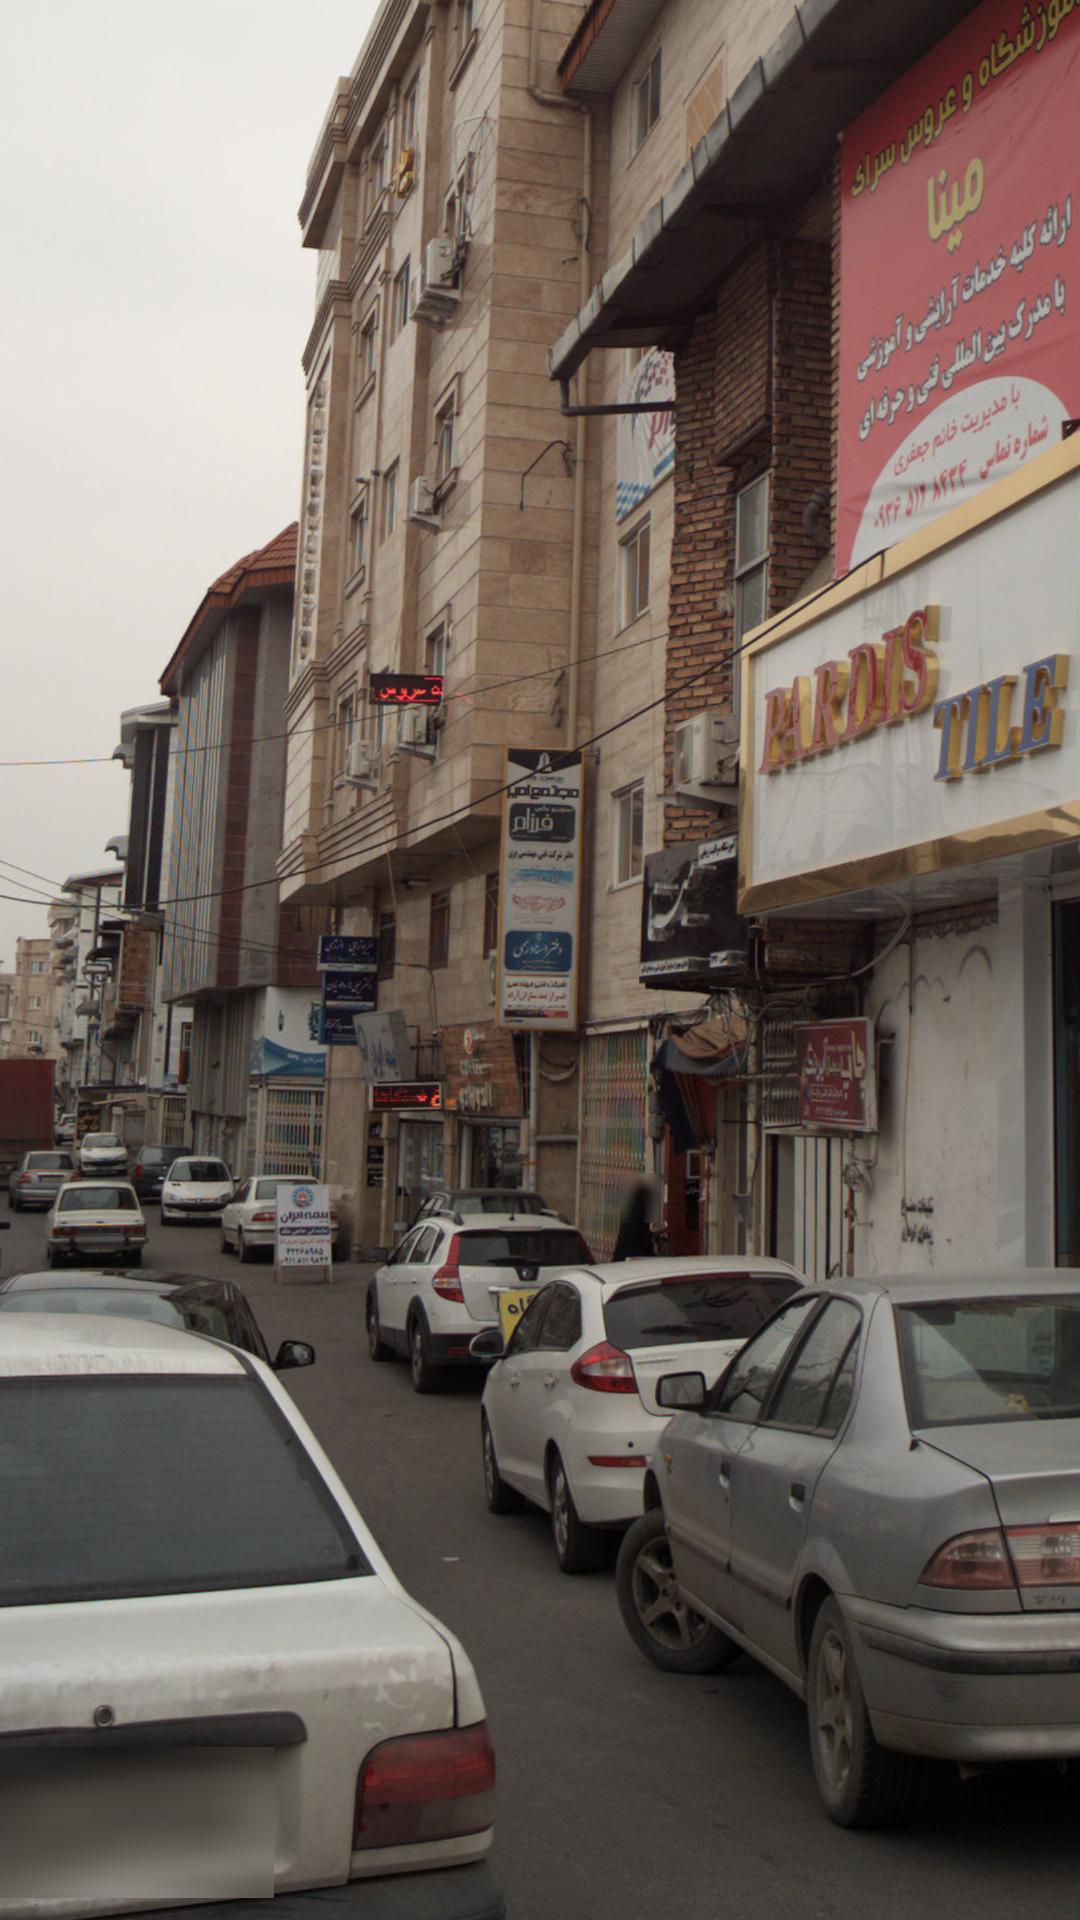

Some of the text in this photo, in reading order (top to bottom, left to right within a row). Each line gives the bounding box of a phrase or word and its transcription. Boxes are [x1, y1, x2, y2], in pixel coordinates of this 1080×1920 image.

[851, 0, 1080, 196] موزشگاه و عروس سرای
[927, 157, 984, 253] مینا
[1009, 220, 1037, 272] کلیه
[962, 246, 1007, 302] خدمات
[1053, 274, 1066, 315] با
[914, 272, 961, 342] آرایشی
[1008, 297, 1051, 341] مدرک
[857, 312, 903, 381] آموزشی
[906, 322, 914, 351] و
[906, 384, 915, 413] و
[917, 354, 940, 405] فنی
[893, 384, 1021, 477] با مدیریت خانم جعفری
[1012, 413, 1050, 461] شماره
[979, 433, 1011, 480] تماس
[759, 604, 941, 777] PARDIS
[932, 653, 1071, 784] TILE
[544, 938, 563, 959] دفتر
[280, 1210, 329, 1224] بیمه ایران
